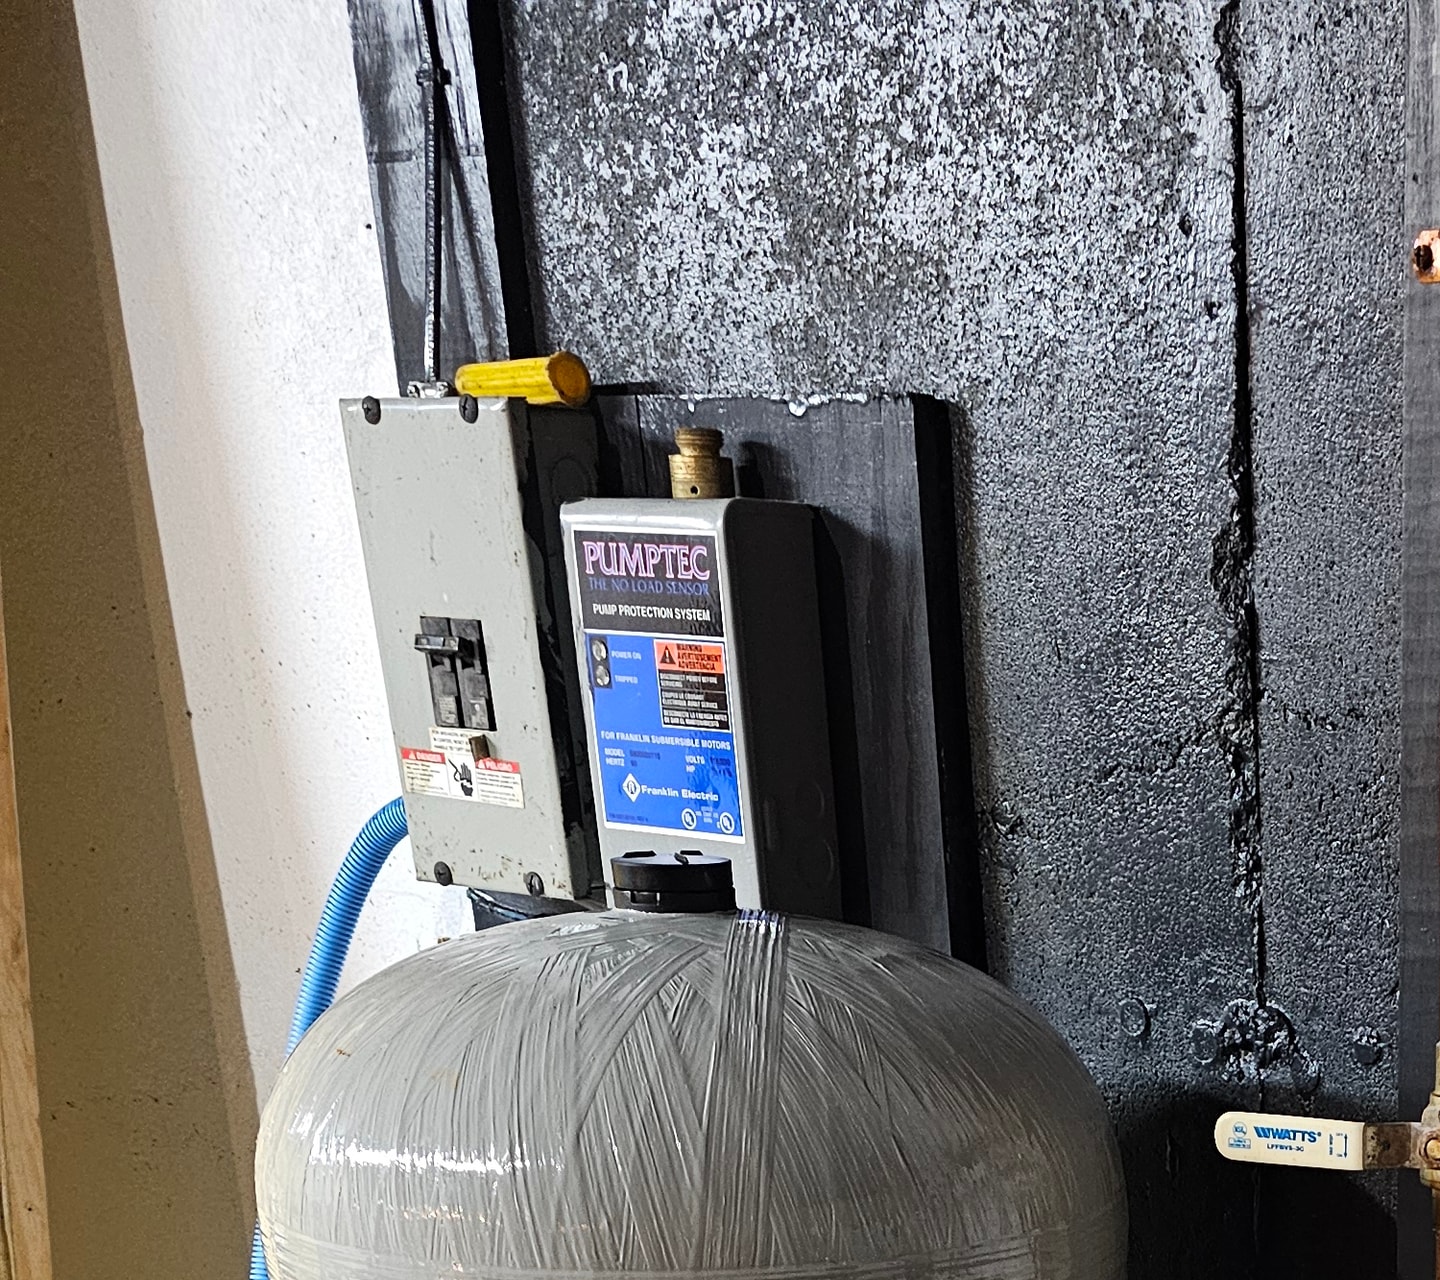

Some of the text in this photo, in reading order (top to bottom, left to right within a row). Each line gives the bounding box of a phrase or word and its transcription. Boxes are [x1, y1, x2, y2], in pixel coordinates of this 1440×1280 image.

[583, 541, 710, 580] PUMPTEC
[589, 577, 710, 595] THE NO LOAD SENSOR
[593, 603, 711, 621] PUMP PROTECTION SYSTEM
[611, 650, 632, 659] POWER
[615, 675, 638, 683] TRIPPED
[600, 730, 731, 750] FOR FRANKLIN SUBMERSIBLE MOTORS
[485, 761, 514, 772] PELIGRO
[641, 784, 719, 802] Franklin Electric
